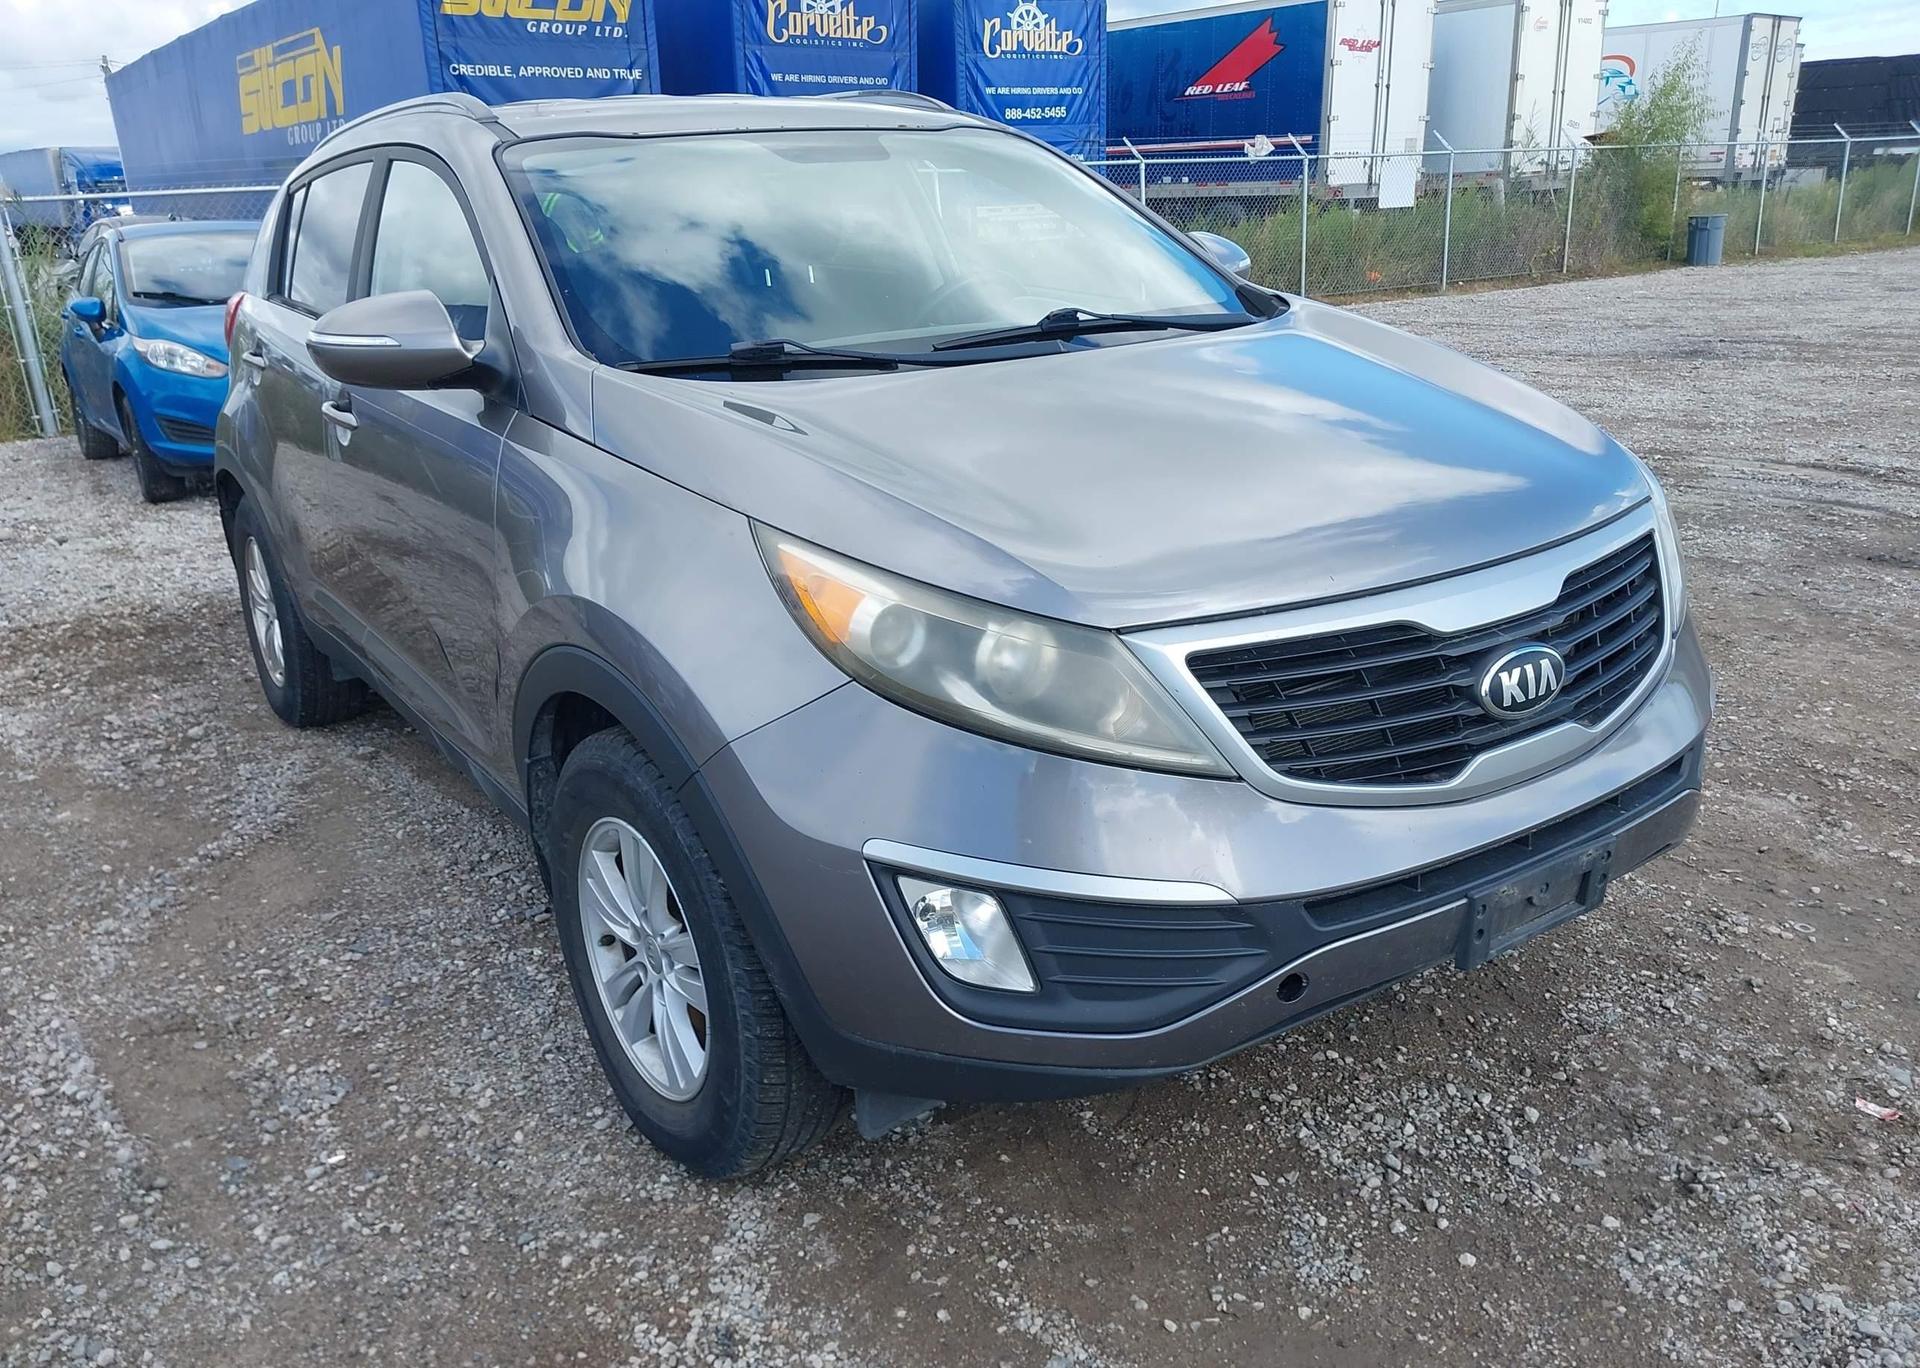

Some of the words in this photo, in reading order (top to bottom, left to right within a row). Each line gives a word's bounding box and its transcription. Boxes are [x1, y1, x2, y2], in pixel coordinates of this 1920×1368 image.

[526, 20, 588, 36] GROUP
[594, 25, 629, 38] LTD.
[767, 0, 888, 44] Corvette
[789, 38, 842, 47] LOGISTICS
[983, 17, 1083, 58] Corvette
[449, 63, 517, 79] CREDIBLE,
[518, 66, 584, 79] APPROVED
[586, 67, 611, 79] AND
[612, 68, 643, 80] TRUE
[770, 72, 784, 81] WE
[784, 73, 800, 82] ARE
[801, 74, 827, 84] HIRING
[827, 75, 858, 85] DRIVERS
[858, 76, 875, 85] AND
[985, 87, 996, 95] WE
[997, 87, 1010, 95] ARE
[1010, 87, 1032, 95] HIRING
[1032, 87, 1058, 95] DRIVERS
[1059, 87, 1072, 95] AND
[1184, 84, 1214, 96] RED
[1215, 81, 1250, 94] LEAF
[1004, 106, 1067, 120] 888-452-5455
[287, 121, 321, 146] GROUP
[1498, 658, 1557, 707] KIA
